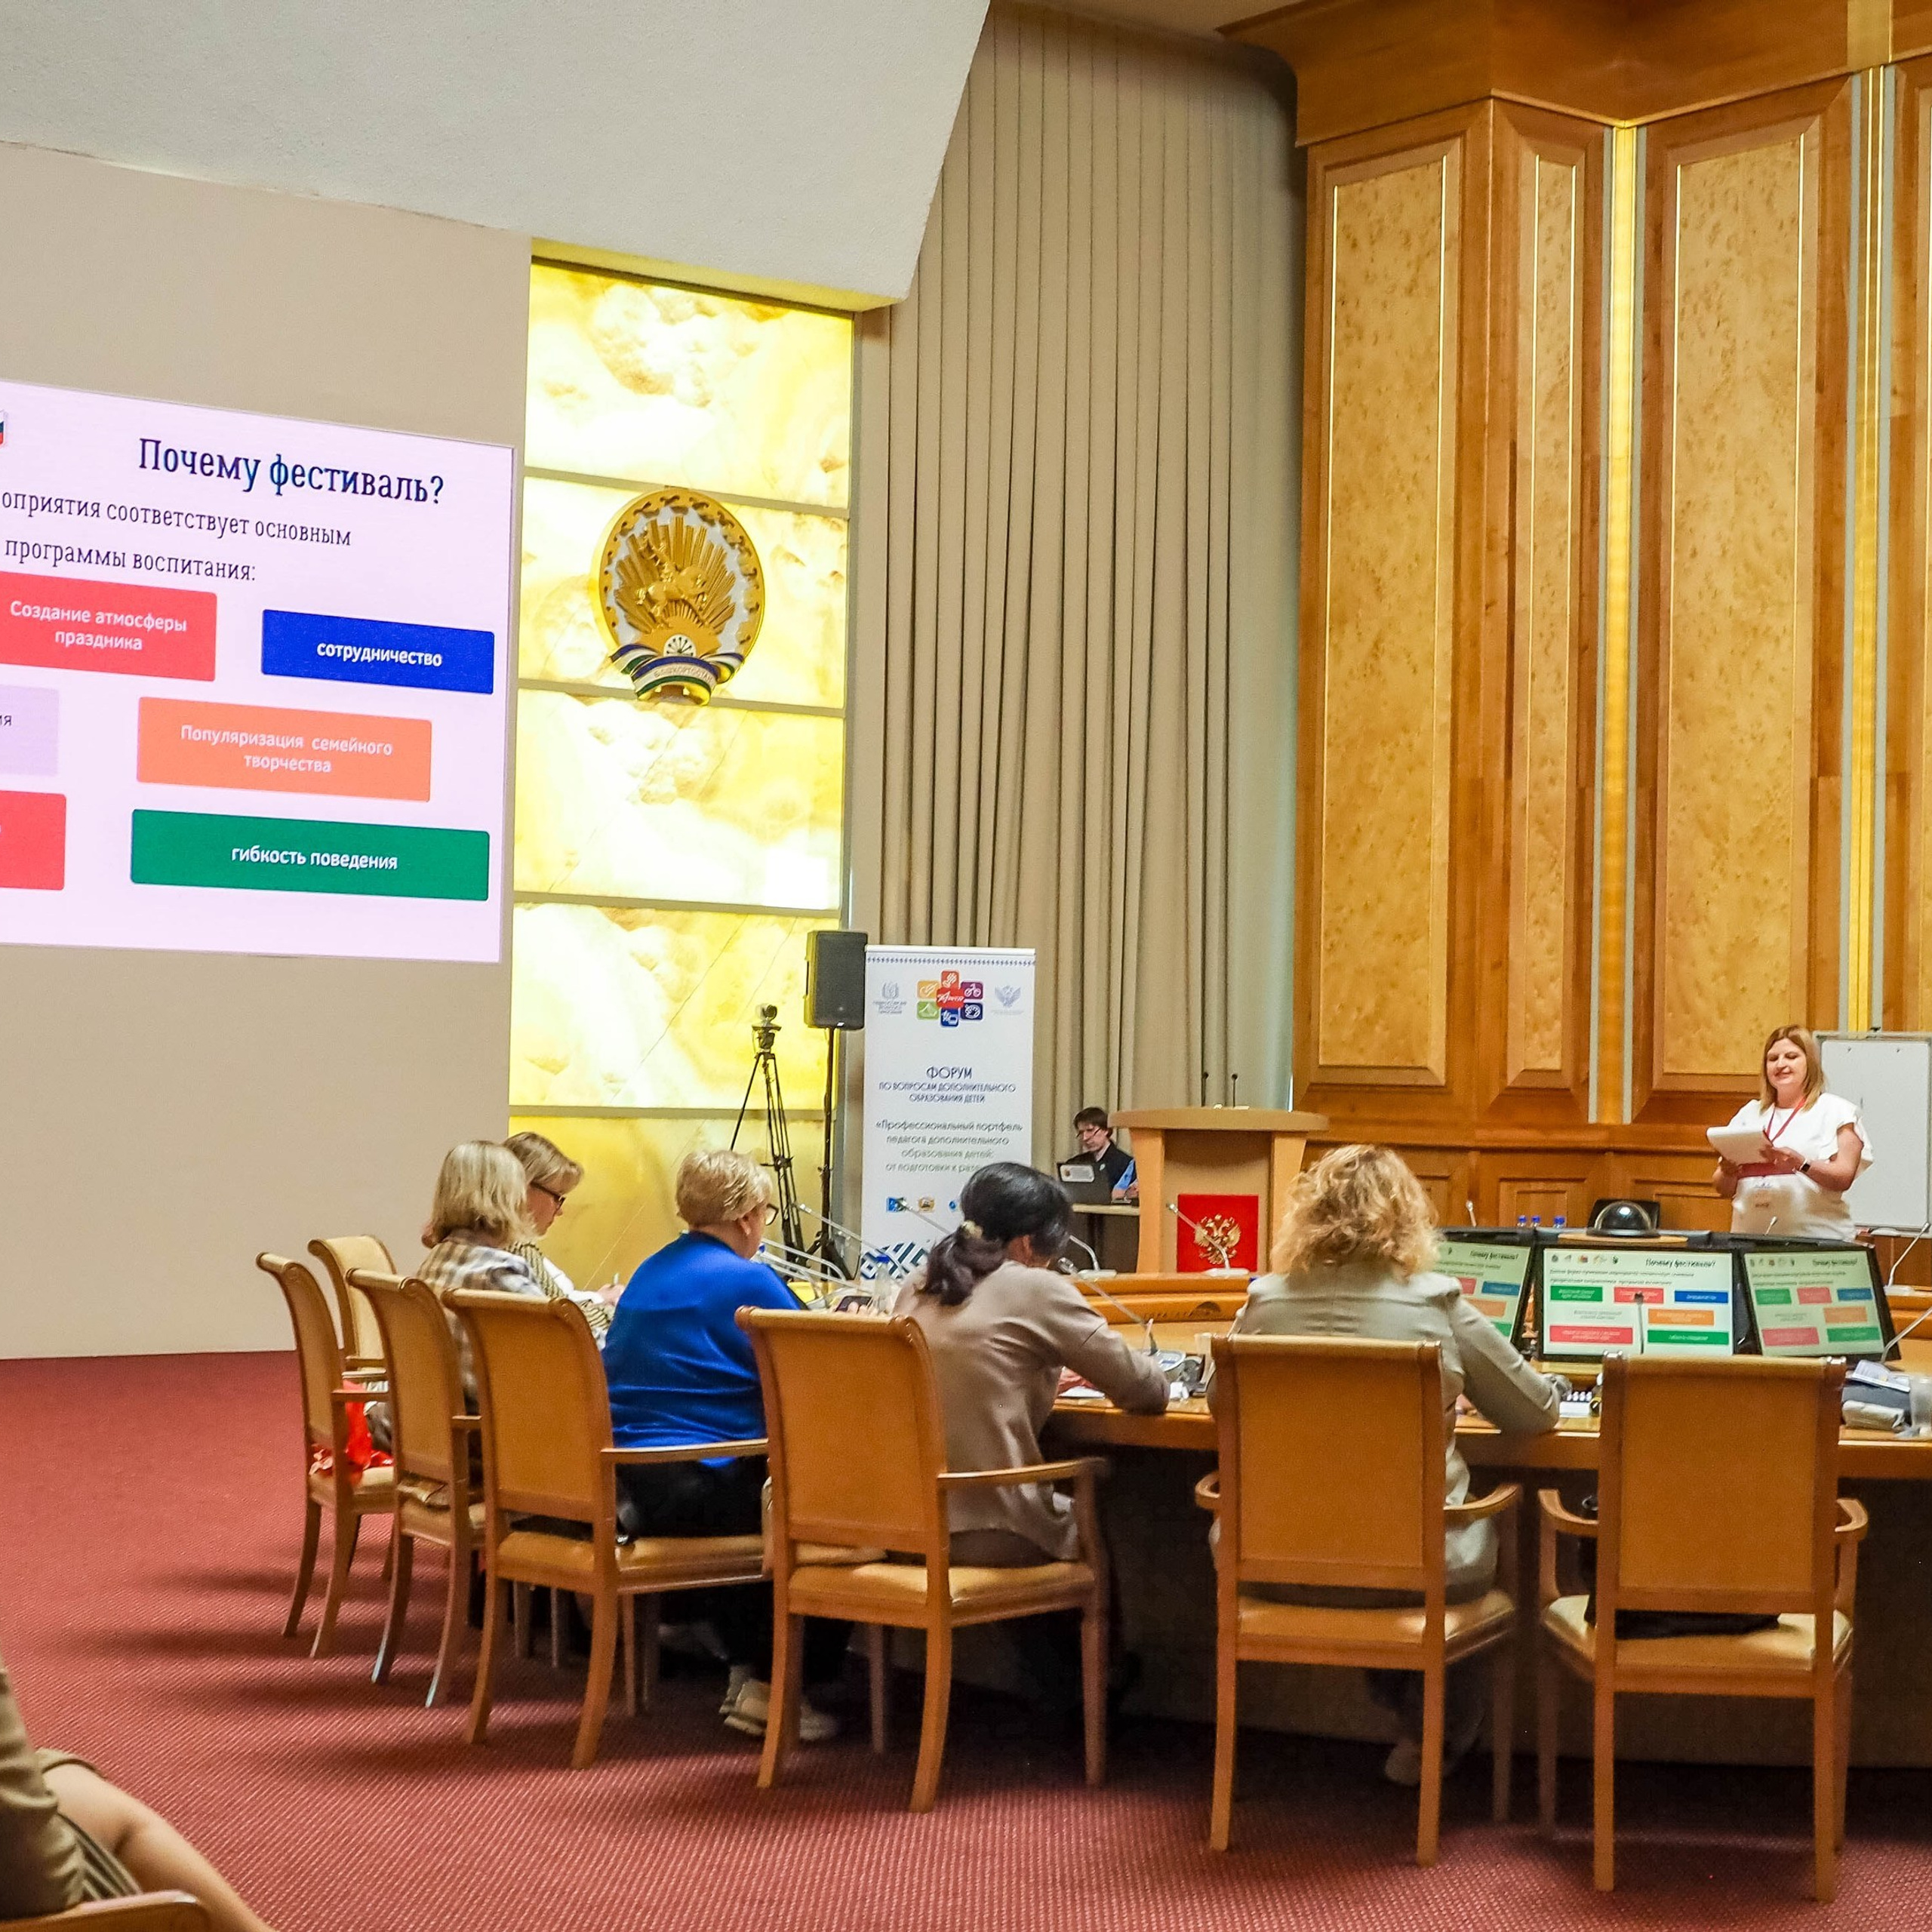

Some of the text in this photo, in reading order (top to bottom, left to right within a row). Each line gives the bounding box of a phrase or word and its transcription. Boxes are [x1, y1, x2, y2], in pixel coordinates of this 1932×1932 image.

[138, 438, 444, 504] Почему фестиваль?
[2, 492, 351, 546] оприятия соответствует основным
[5, 540, 256, 581] программы воспитания:
[11, 601, 187, 632] Создание атмосферы
[55, 628, 142, 651] праздника
[317, 641, 442, 667] сотрудничество
[180, 724, 392, 757] Популяризация семейного
[244, 754, 331, 773] творчества
[232, 845, 398, 870] гибкость поведения
[926, 1066, 972, 1079] ФОРУМ
[879, 1081, 1016, 1092] ПО ВОПРОСАМ ДОПОЛНИТЕЛЬНОГО
[964, 1094, 985, 1103] ДЕТЕЙ
[876, 1119, 1023, 1133] «Профессиональный портфель
[886, 1135, 1010, 1146] педагога дополнительного
[901, 1148, 963, 1159] образования
[898, 1164, 952, 1173] подготовки
